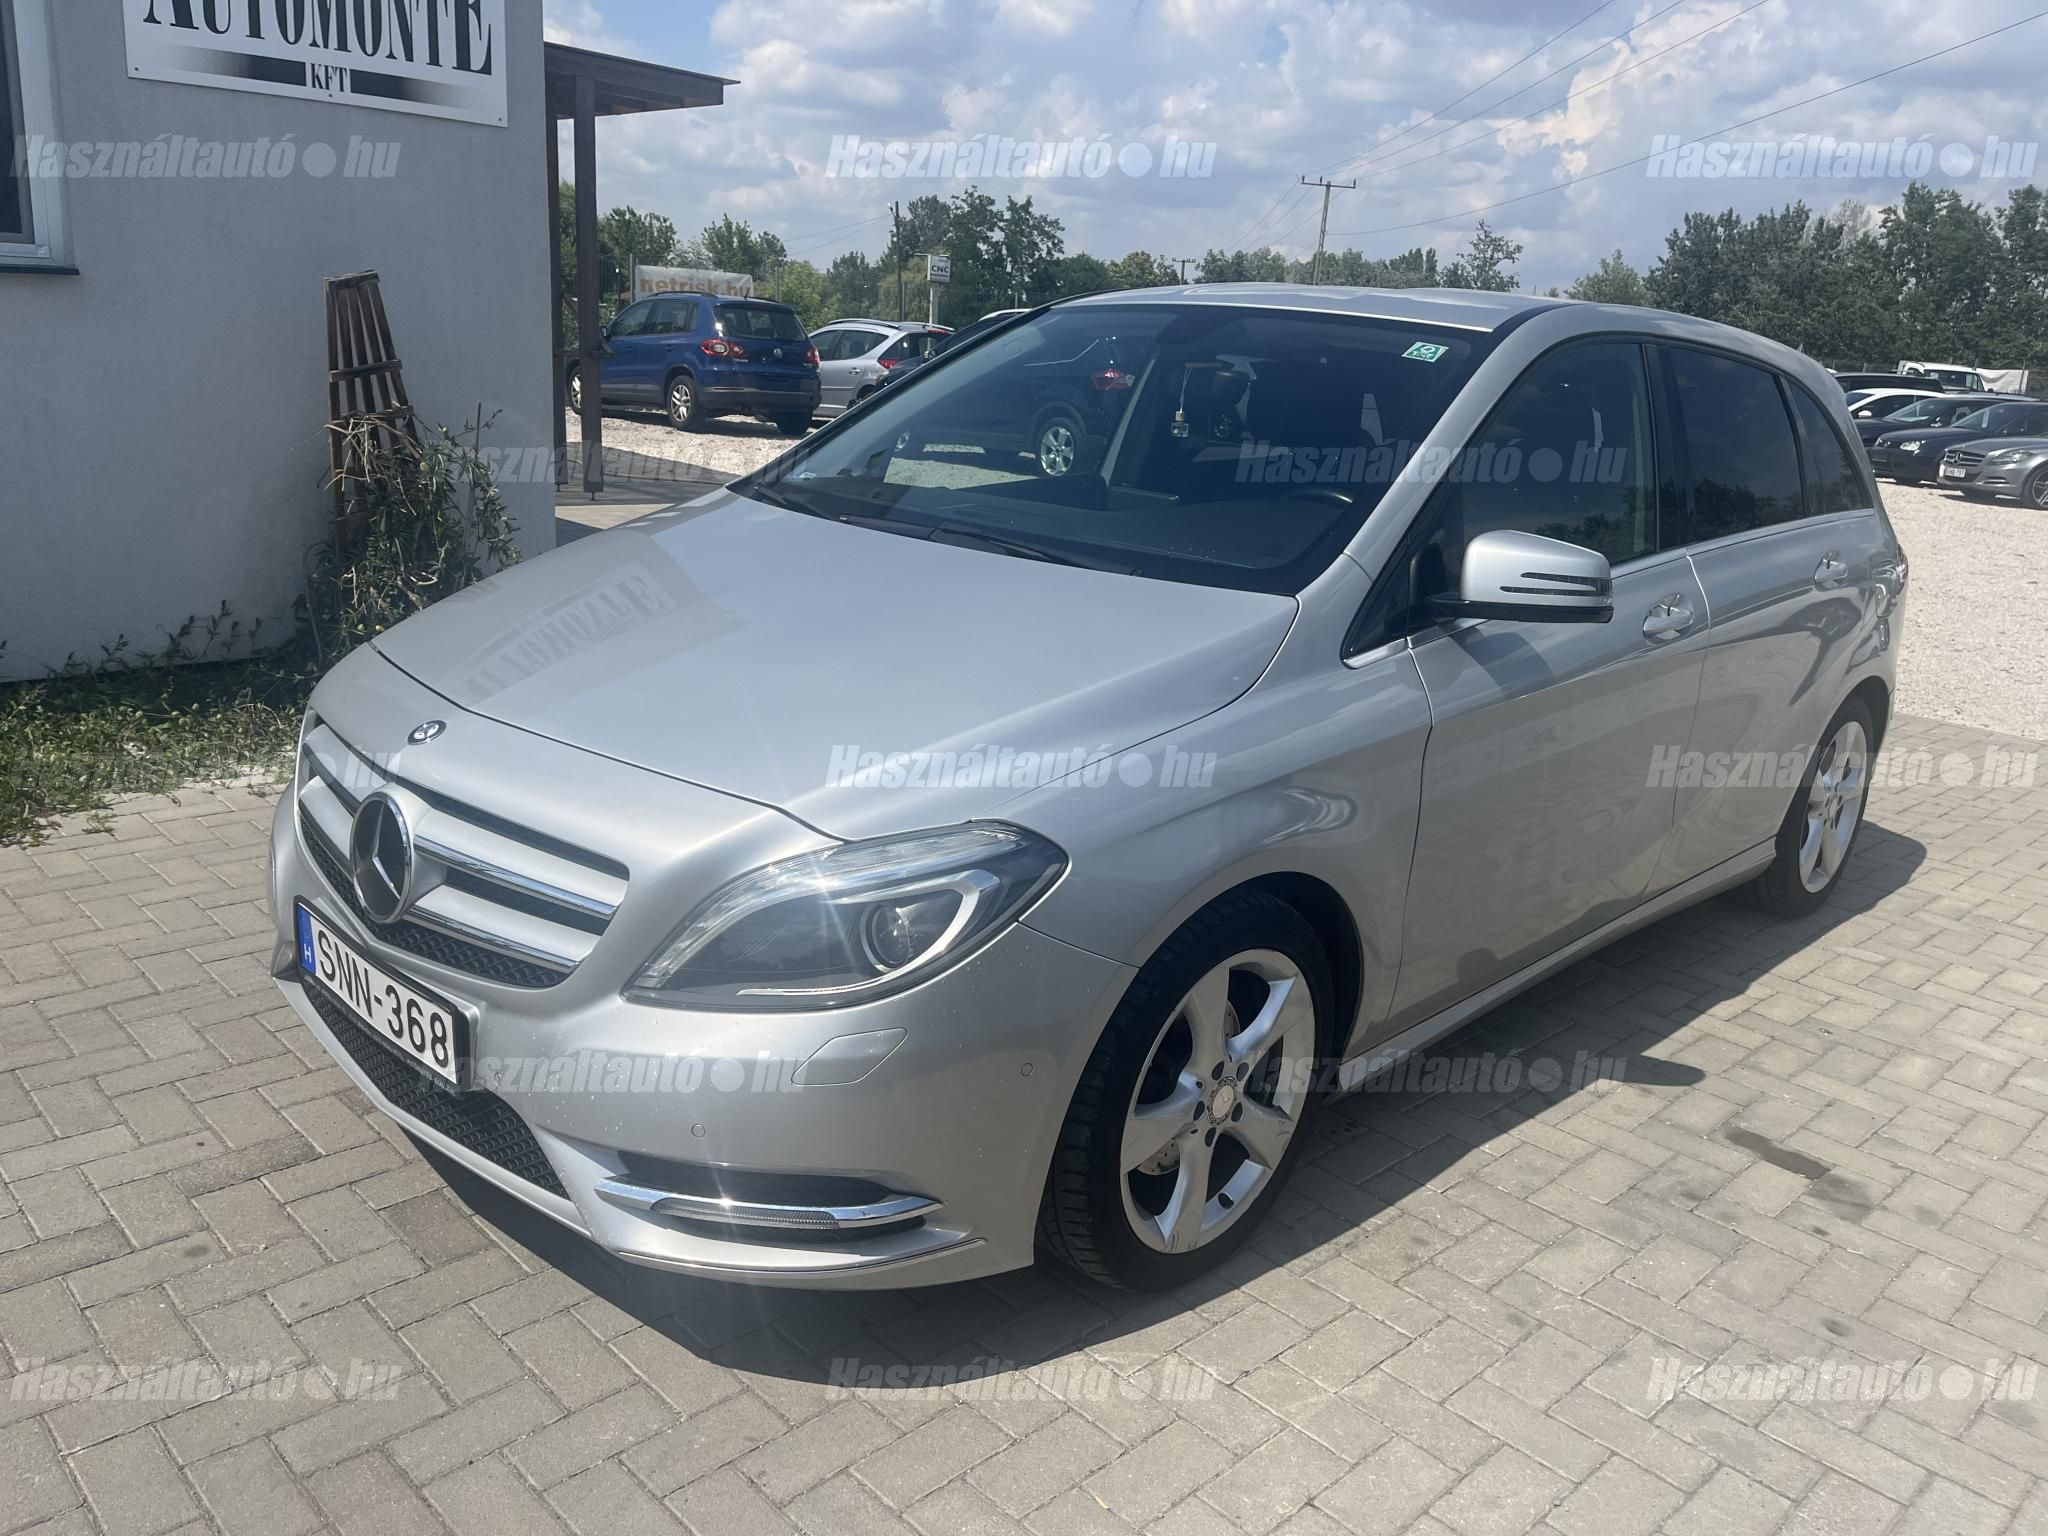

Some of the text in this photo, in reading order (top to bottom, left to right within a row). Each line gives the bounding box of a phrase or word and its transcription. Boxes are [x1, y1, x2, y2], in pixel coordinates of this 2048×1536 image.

[310, 62, 348, 93] KFT
[931, 264, 949, 274] CNC
[318, 929, 449, 1069] SNN-368
